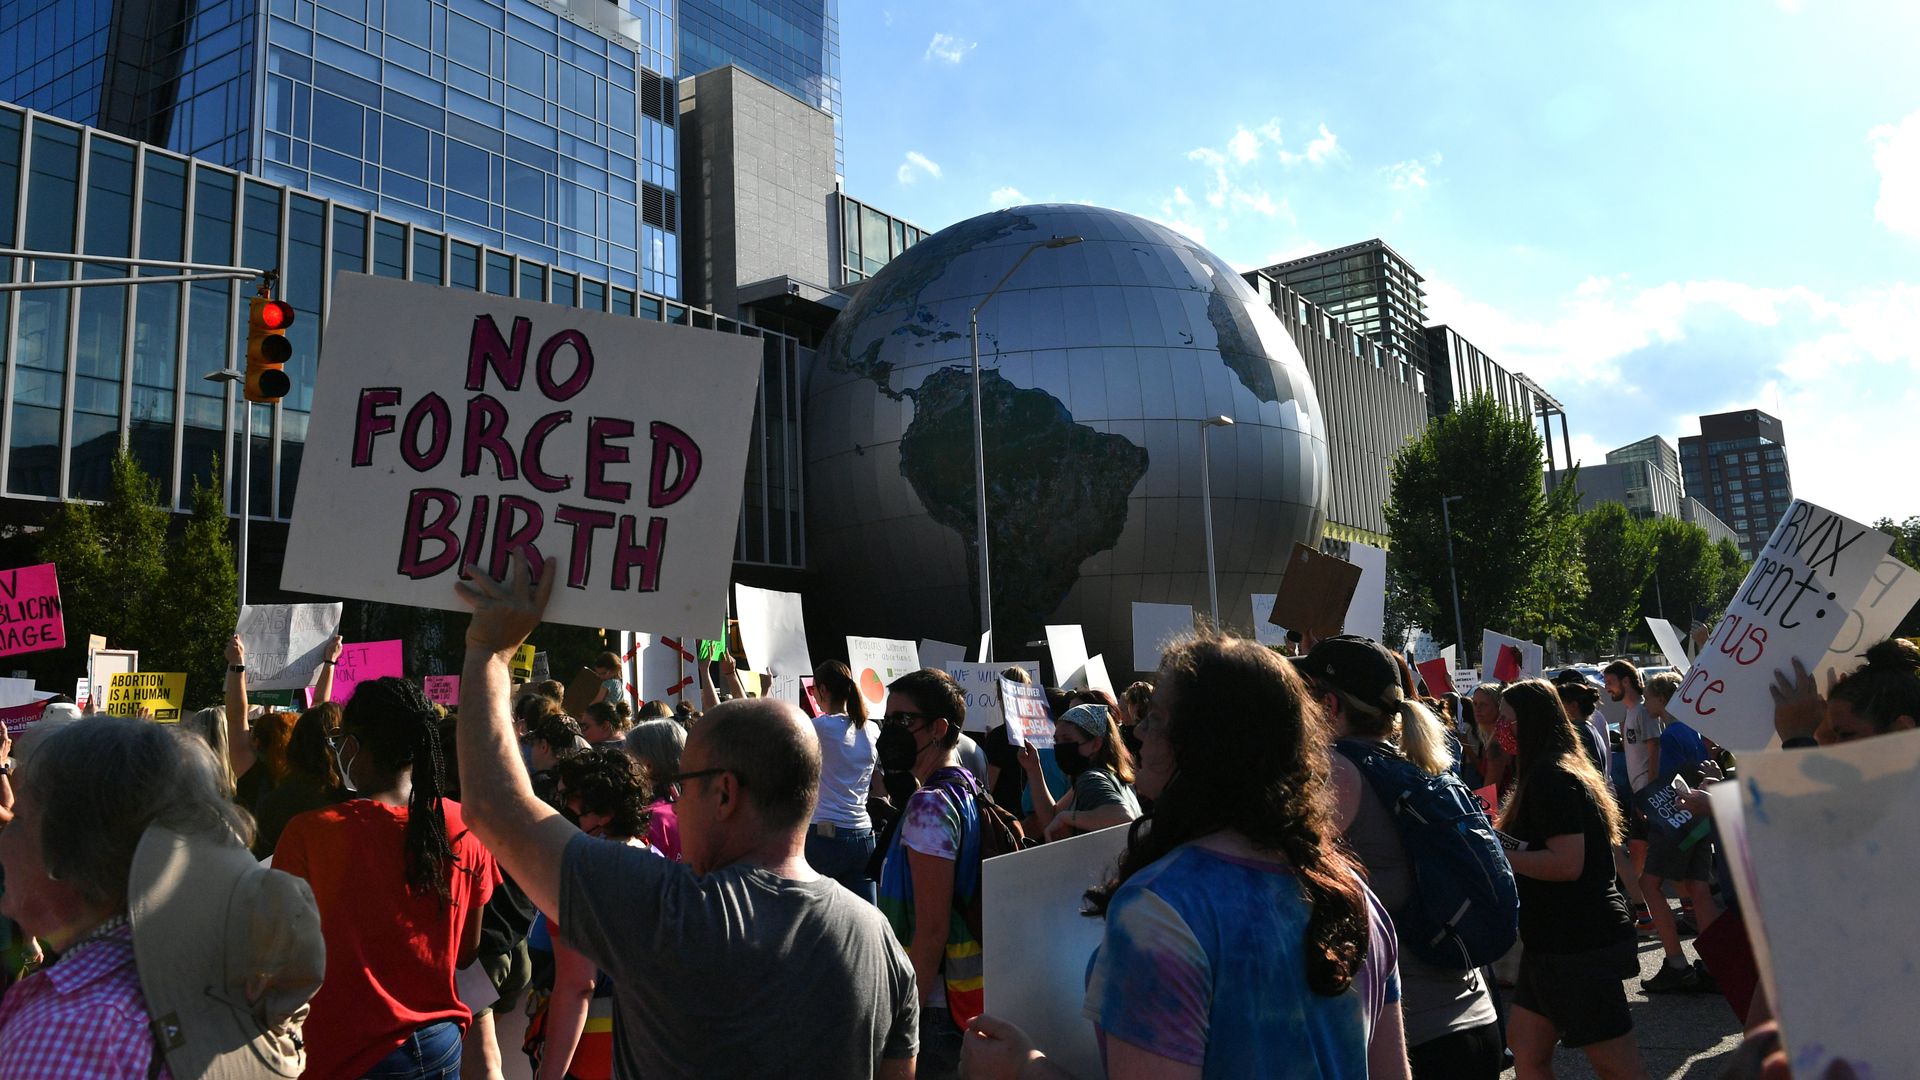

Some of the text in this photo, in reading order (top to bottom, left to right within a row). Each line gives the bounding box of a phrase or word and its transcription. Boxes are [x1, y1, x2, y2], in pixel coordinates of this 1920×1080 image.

[464, 313, 594, 401] NO
[351, 386, 703, 508] FORCED
[398, 487, 668, 592] BIRTH
[109, 687, 171, 701] IS A HUMAN
[111, 674, 164, 687] ABORTION
[1648, 785, 1676, 809] BANS
